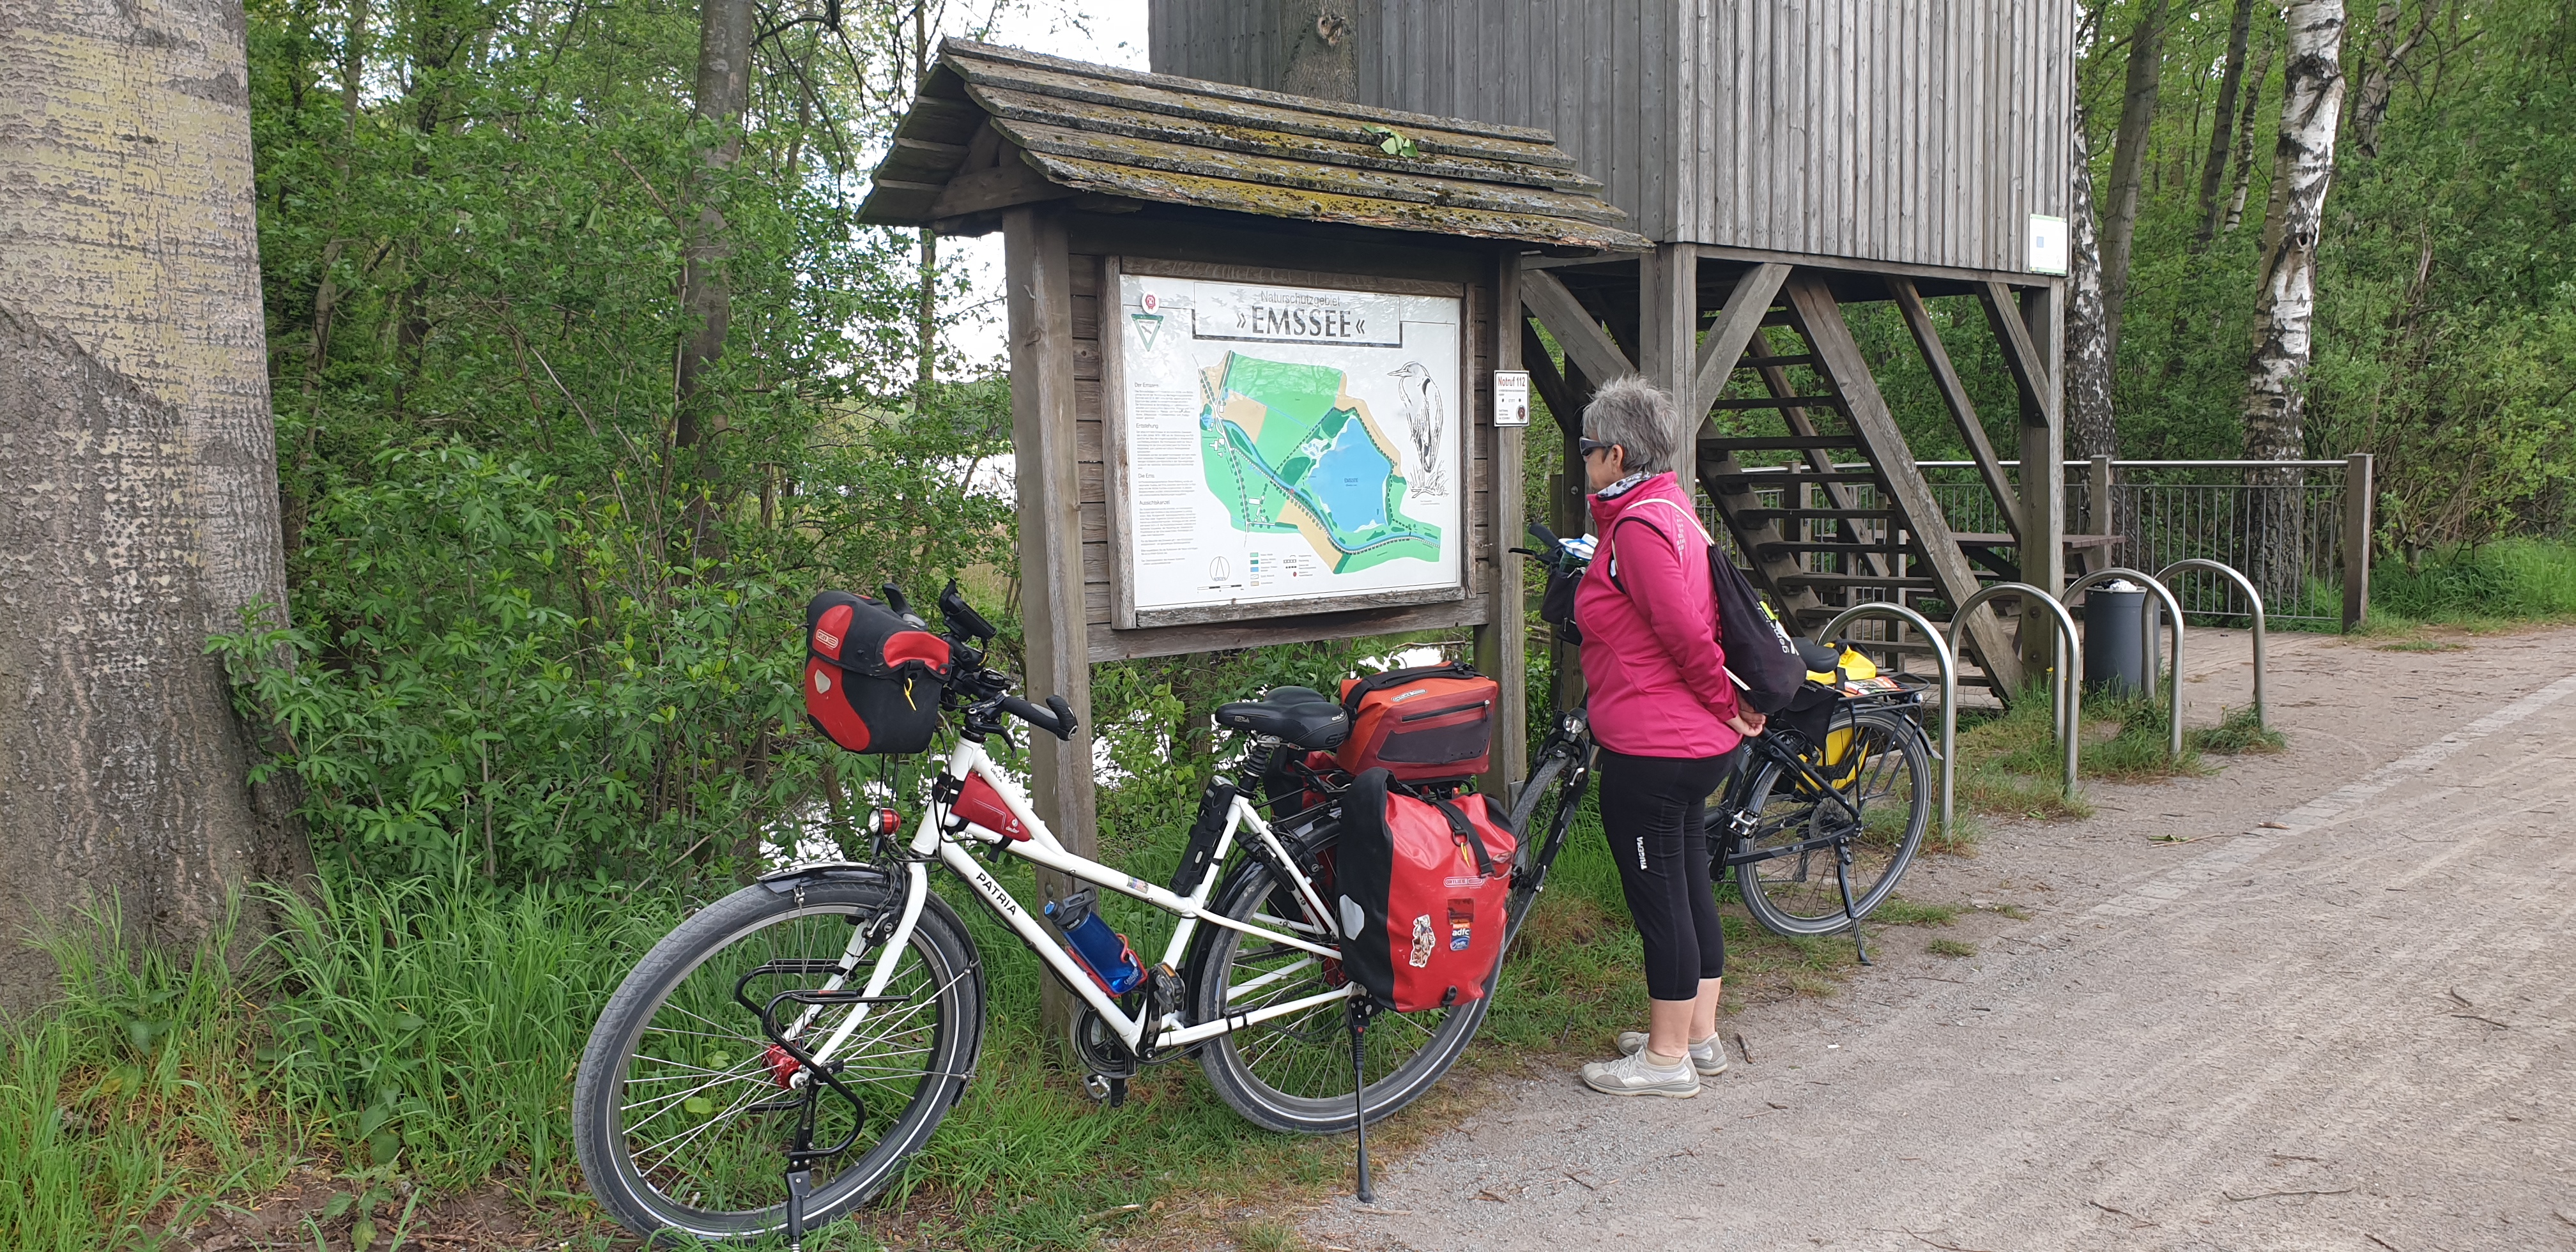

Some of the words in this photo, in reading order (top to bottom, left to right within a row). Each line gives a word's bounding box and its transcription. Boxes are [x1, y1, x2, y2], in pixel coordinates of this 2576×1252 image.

[1261, 290, 1340, 308] Naturschutzgebiet
[1498, 376, 1515, 387] Notruf
[1517, 376, 1525, 387] 112
[1636, 836, 1648, 870] TRIGEMA
[976, 872, 1016, 916] PATRIA
[1452, 928, 1469, 936] adfc
